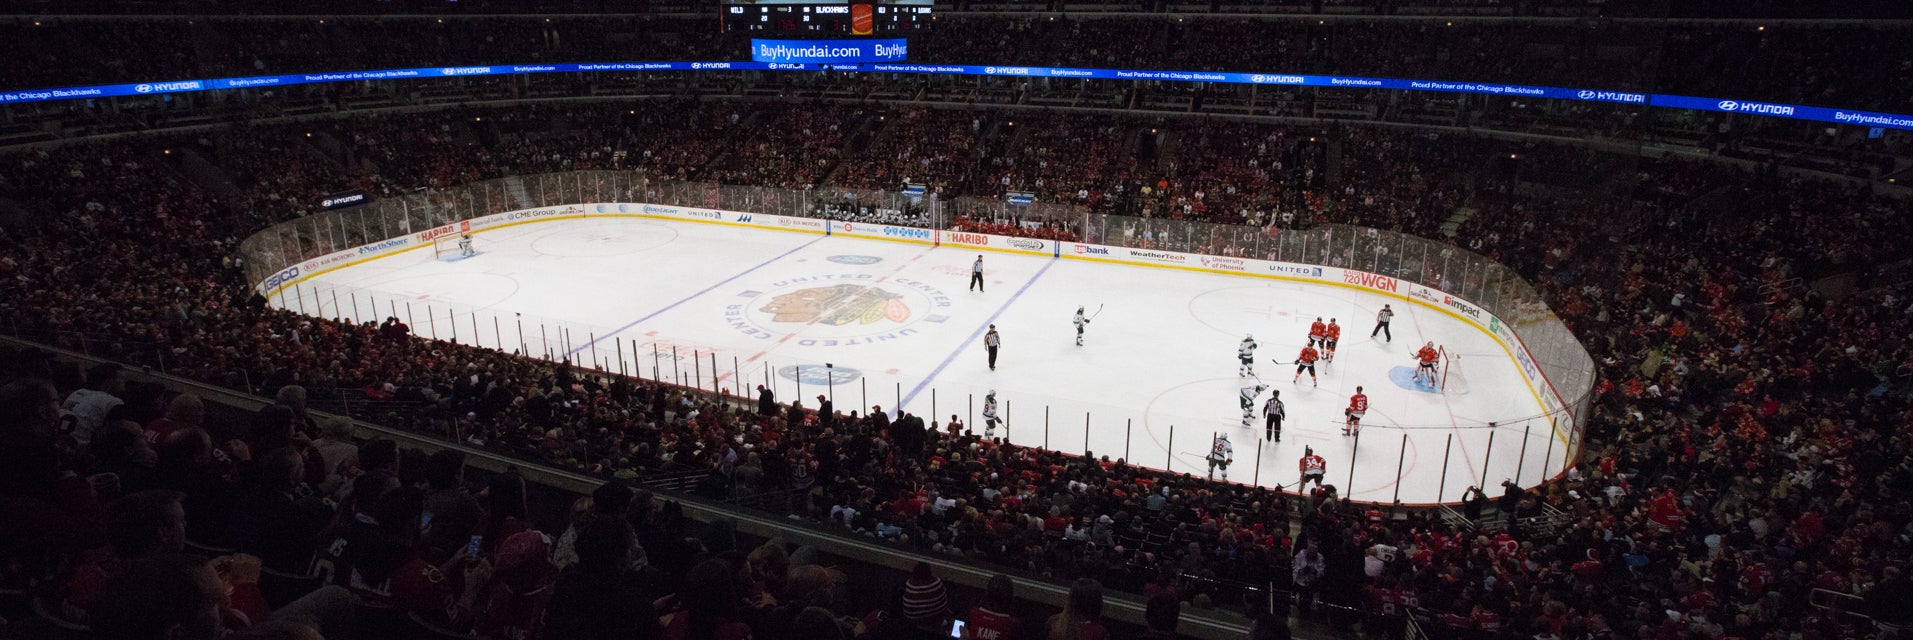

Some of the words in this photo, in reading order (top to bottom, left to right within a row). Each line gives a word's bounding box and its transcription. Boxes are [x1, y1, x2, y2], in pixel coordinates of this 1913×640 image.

[760, 44, 860, 60] BuyHyundai.com
[52, 89, 101, 97] Blackhawks
[154, 81, 200, 92] HYUNDAI
[1504, 86, 1544, 94] Blackhawks
[1598, 92, 1645, 103] HYUNDAI
[1740, 103, 1794, 115] HYUNDAI
[1835, 111, 1913, 127] BuyHyundai.com
[333, 194, 363, 204] HYUNDAI
[533, 208, 556, 216] Group
[364, 238, 408, 254] NorthShore
[952, 232, 988, 246] HARIBO
[1130, 250, 1185, 261] WeatherTech
[1212, 256, 1244, 266] University
[1269, 265, 1310, 274] UNITED
[266, 266, 299, 290] GEICO
[1344, 274, 1360, 284] 720
[1361, 272, 1398, 292] WGN
[772, 274, 873, 288] UNITED
[895, 278, 951, 308] CENTER
[1450, 297, 1480, 318] impact
[722, 304, 772, 340] CENTER
[798, 328, 918, 347] UNITED
[1516, 346, 1536, 381] GEICO
